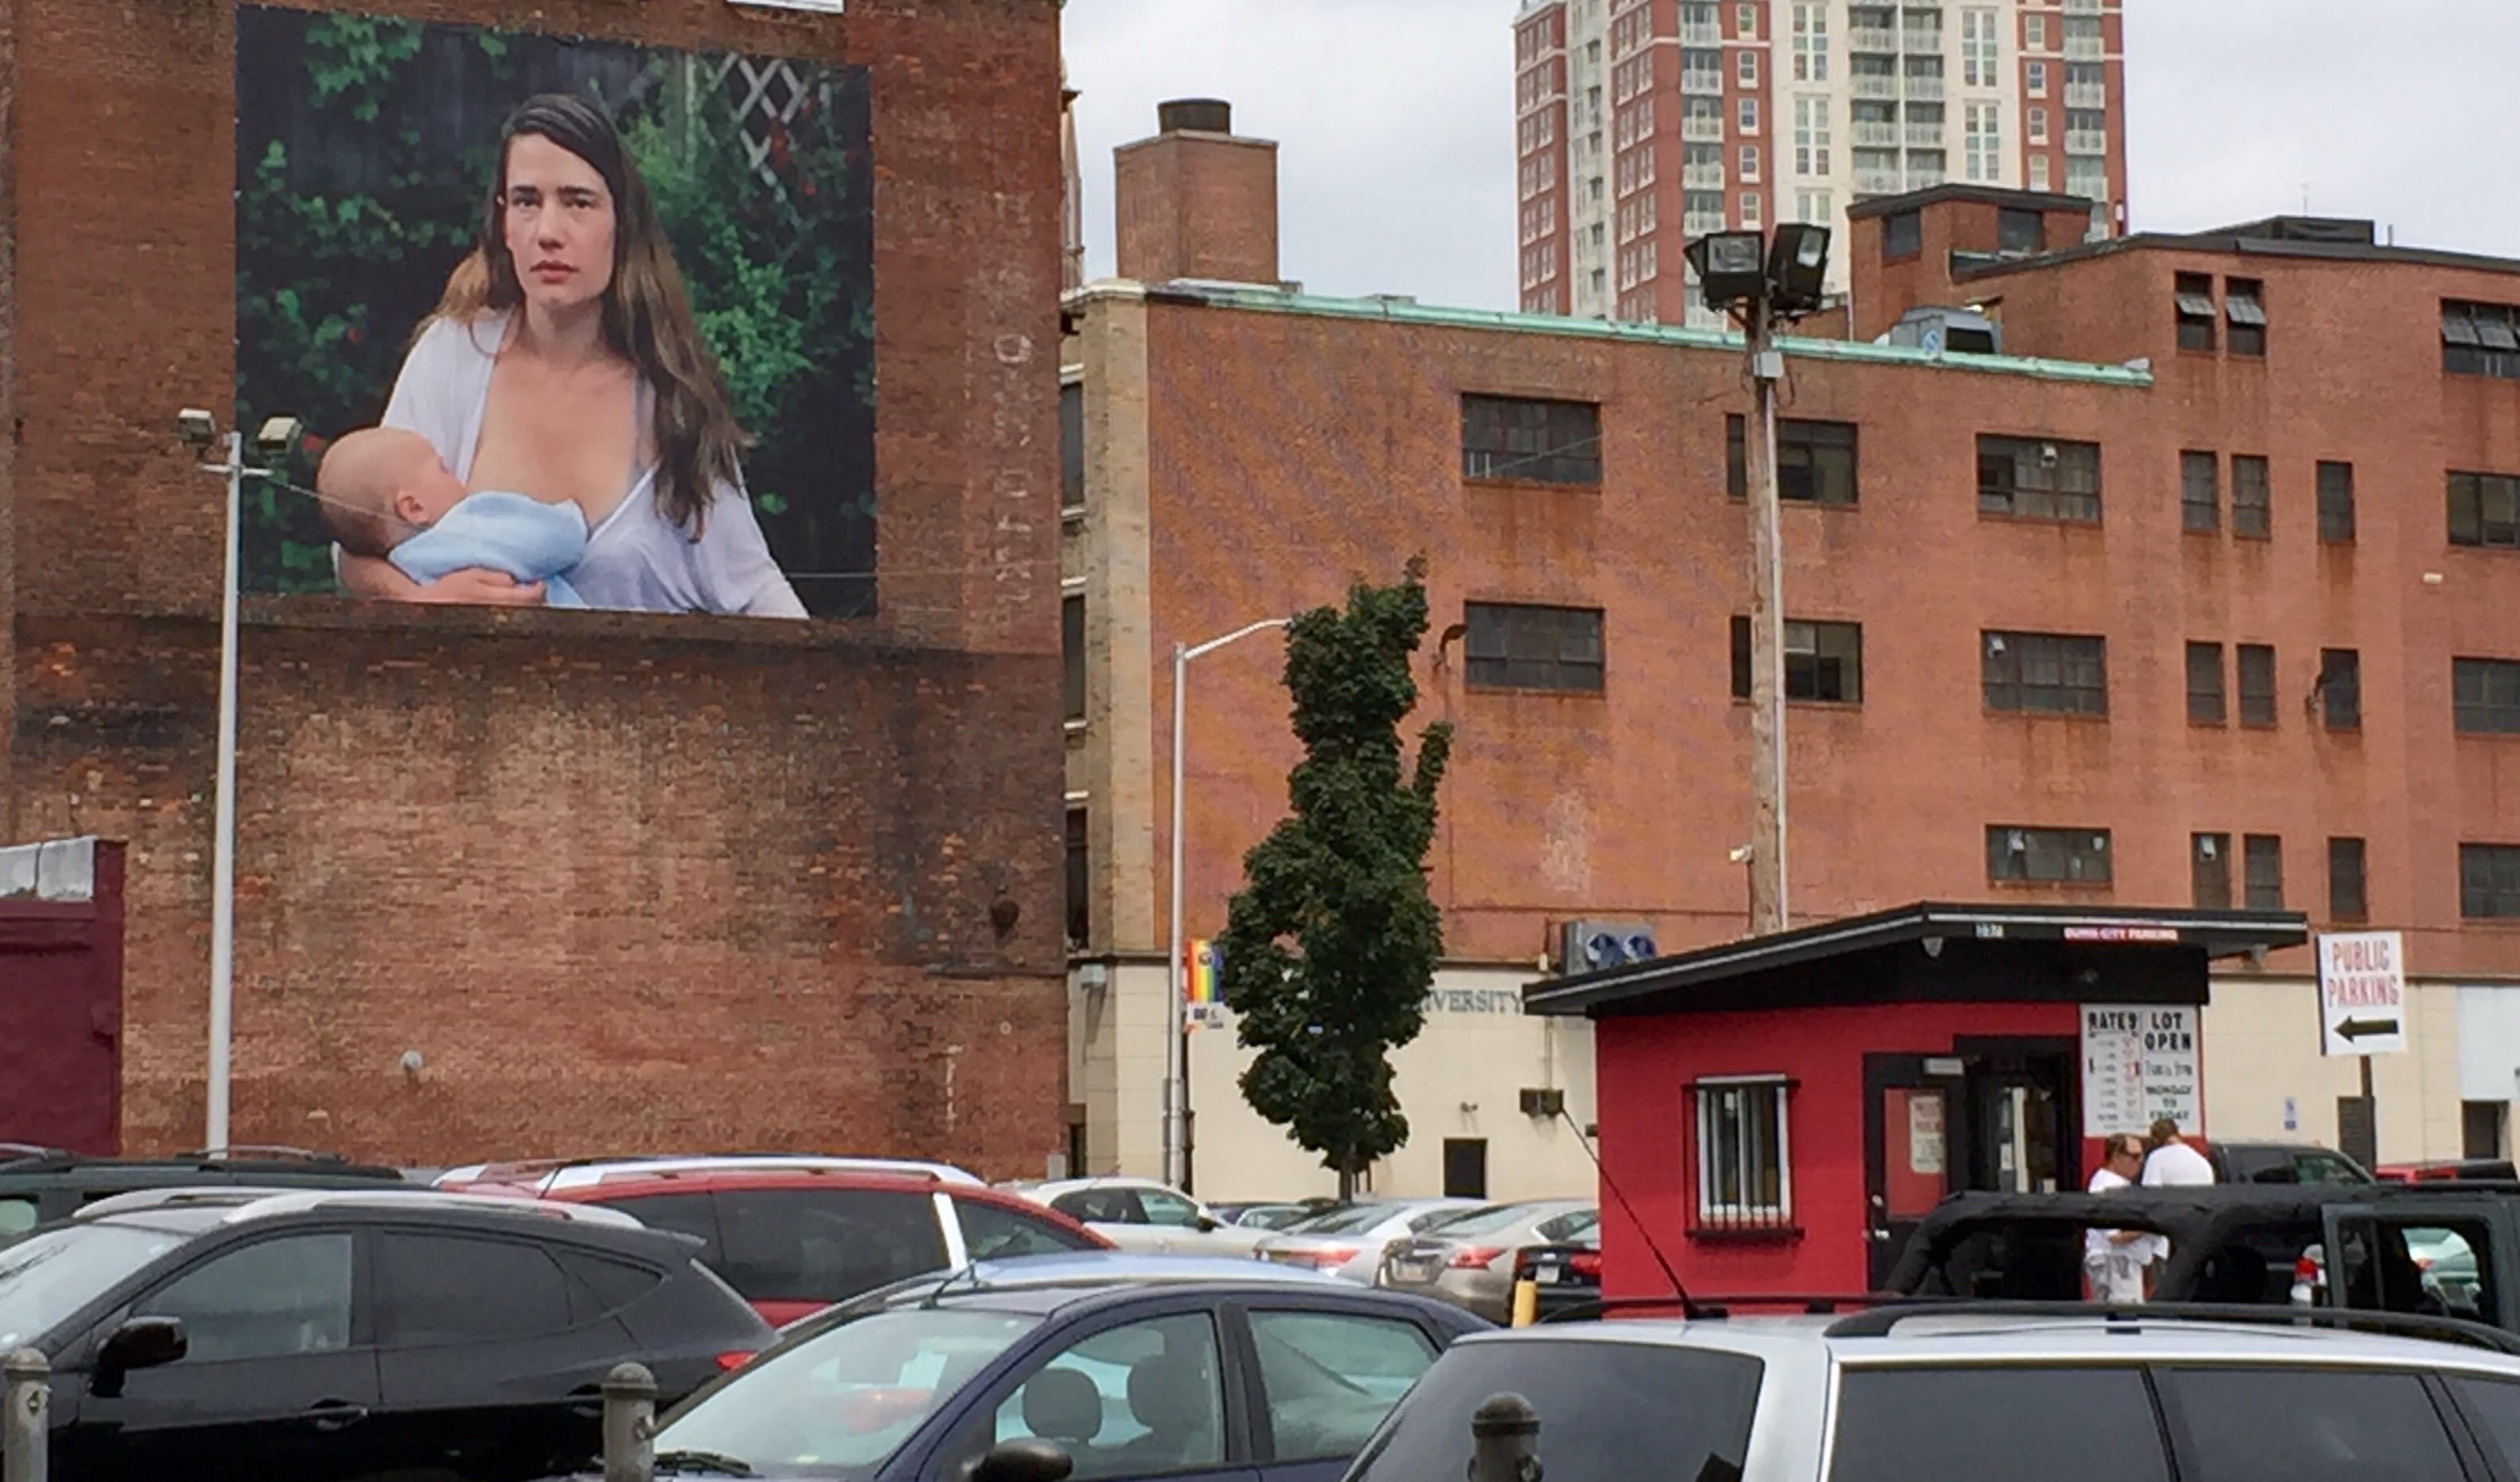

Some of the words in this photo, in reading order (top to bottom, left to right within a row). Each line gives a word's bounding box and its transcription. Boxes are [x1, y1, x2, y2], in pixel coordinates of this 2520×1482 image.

[2332, 940, 2390, 972] PUBLIC
[1425, 989, 1521, 1013] IVERSITY
[2327, 975, 2399, 1007] PARKING
[2152, 1012, 2182, 1030] LOT
[2145, 1032, 2192, 1050] OPEN
